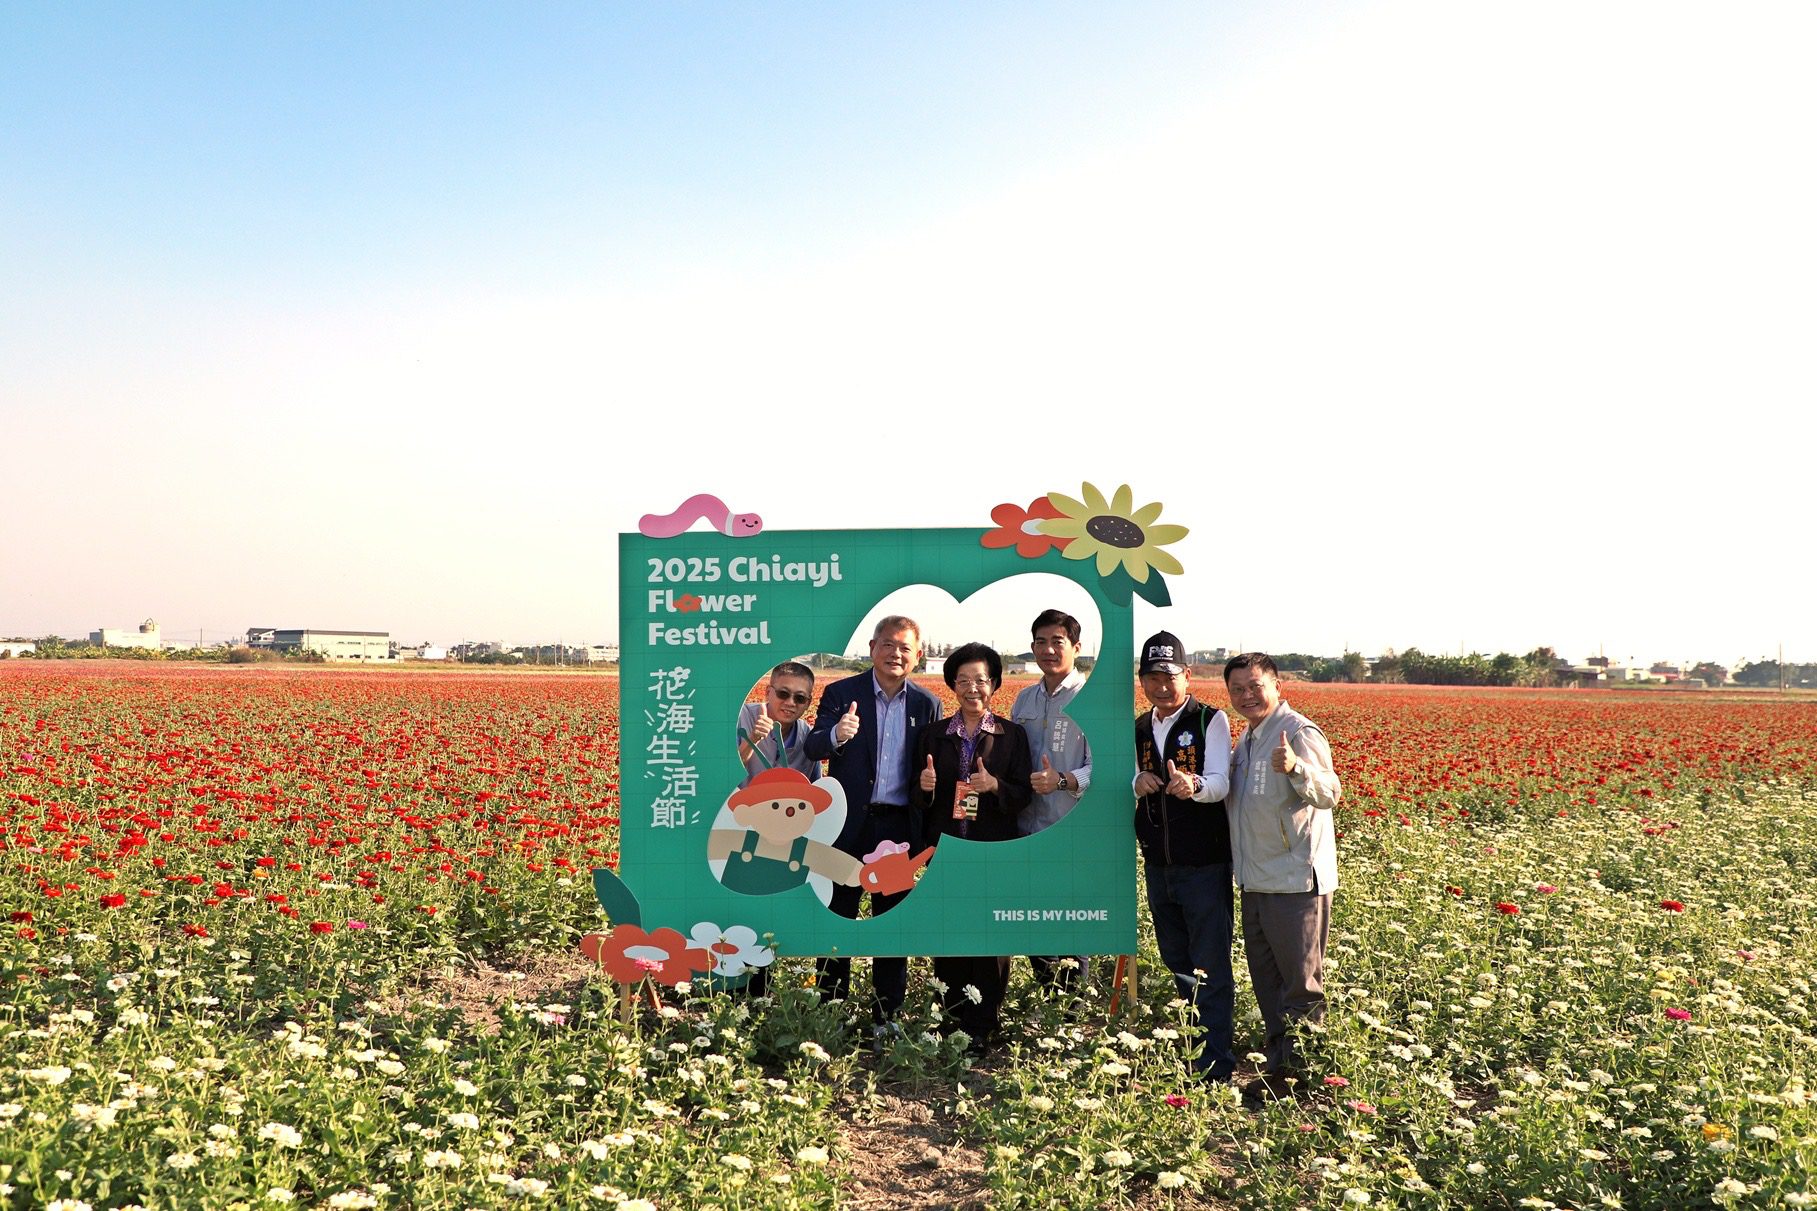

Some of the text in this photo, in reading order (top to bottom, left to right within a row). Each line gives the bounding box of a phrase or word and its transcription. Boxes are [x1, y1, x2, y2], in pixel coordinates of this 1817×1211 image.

[647, 553, 842, 588] 2025 Chiayi
[648, 620, 771, 646] Festival
[646, 666, 699, 829] 花海生活節
[993, 910, 1108, 921] THIS IS MY HOME
